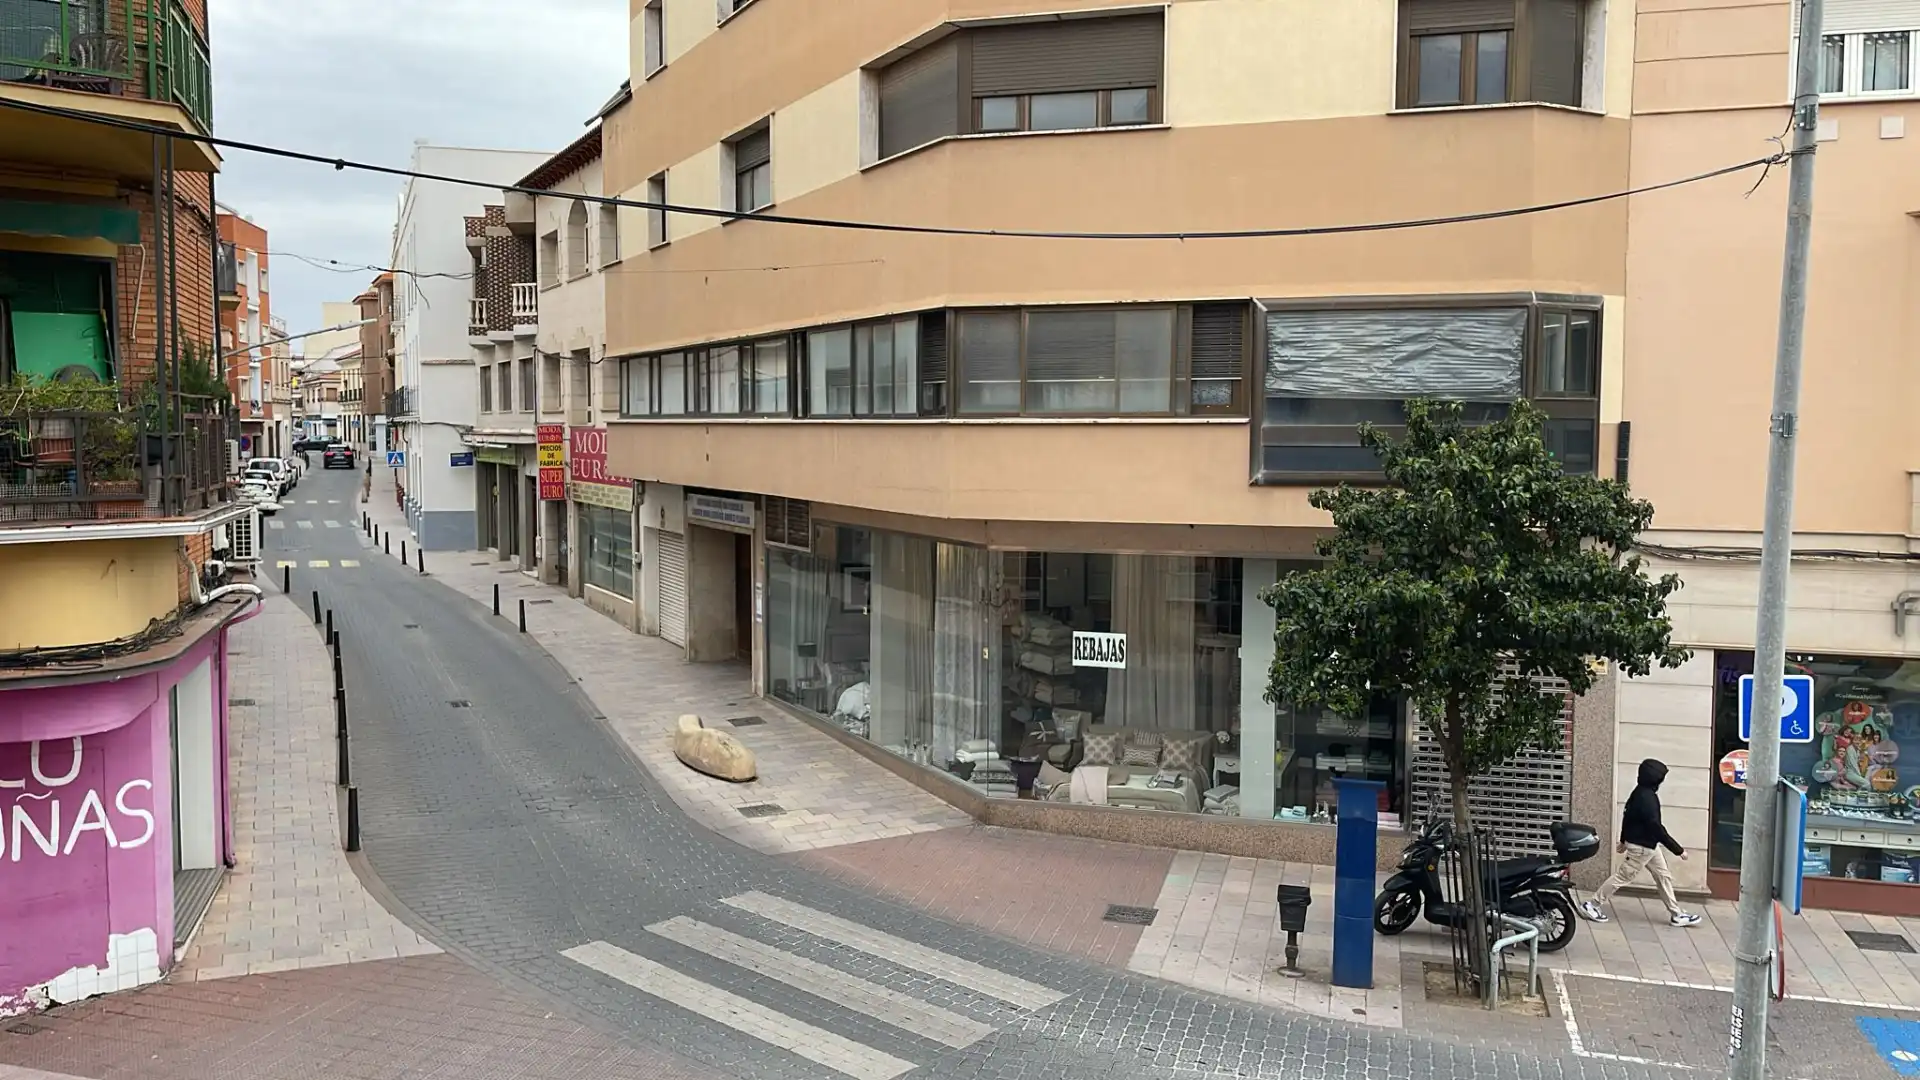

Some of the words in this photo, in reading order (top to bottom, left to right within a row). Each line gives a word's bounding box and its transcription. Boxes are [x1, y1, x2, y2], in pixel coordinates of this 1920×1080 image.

[539, 426, 562, 434] MODA
[540, 470, 563, 483] SUPER
[543, 485, 563, 498] EURO
[1073, 636, 1125, 663] REBAJAS
[0, 778, 155, 863] ÑAS
